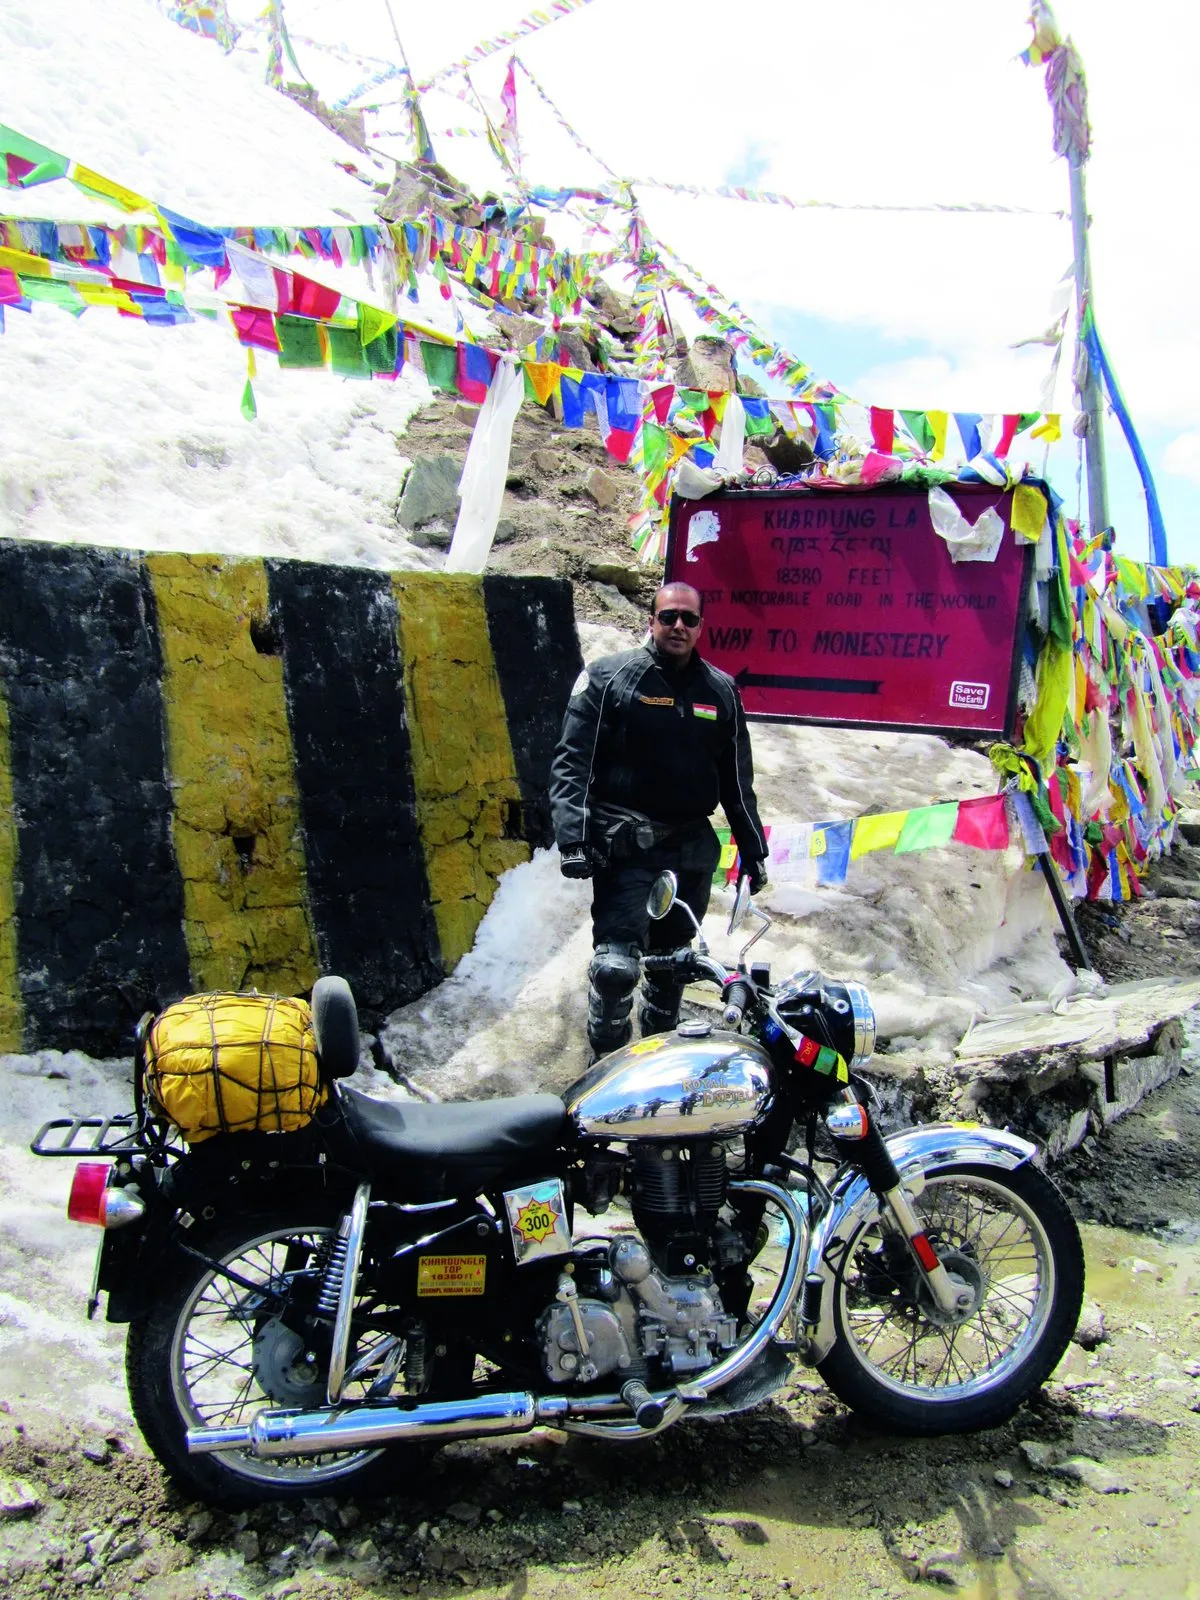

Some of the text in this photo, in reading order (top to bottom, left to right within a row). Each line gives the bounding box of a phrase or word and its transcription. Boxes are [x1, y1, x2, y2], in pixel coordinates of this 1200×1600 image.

[763, 508, 876, 530] KHARDUNG
[775, 567, 895, 586] 18380 FEET
[730, 590, 810, 606] MOTORABLE
[825, 593, 862, 607] ROAD
[879, 594, 893, 607] IN
[905, 593, 934, 609] THE
[939, 595, 996, 610] WORLD
[706, 626, 948, 658] WAY TO MONESTERY
[955, 685, 984, 696] Save
[681, 1077, 727, 1092] ROYAL
[525, 1213, 549, 1232] 300
[431, 1273, 463, 1281] 18380
[443, 1265, 461, 1274] TOP
